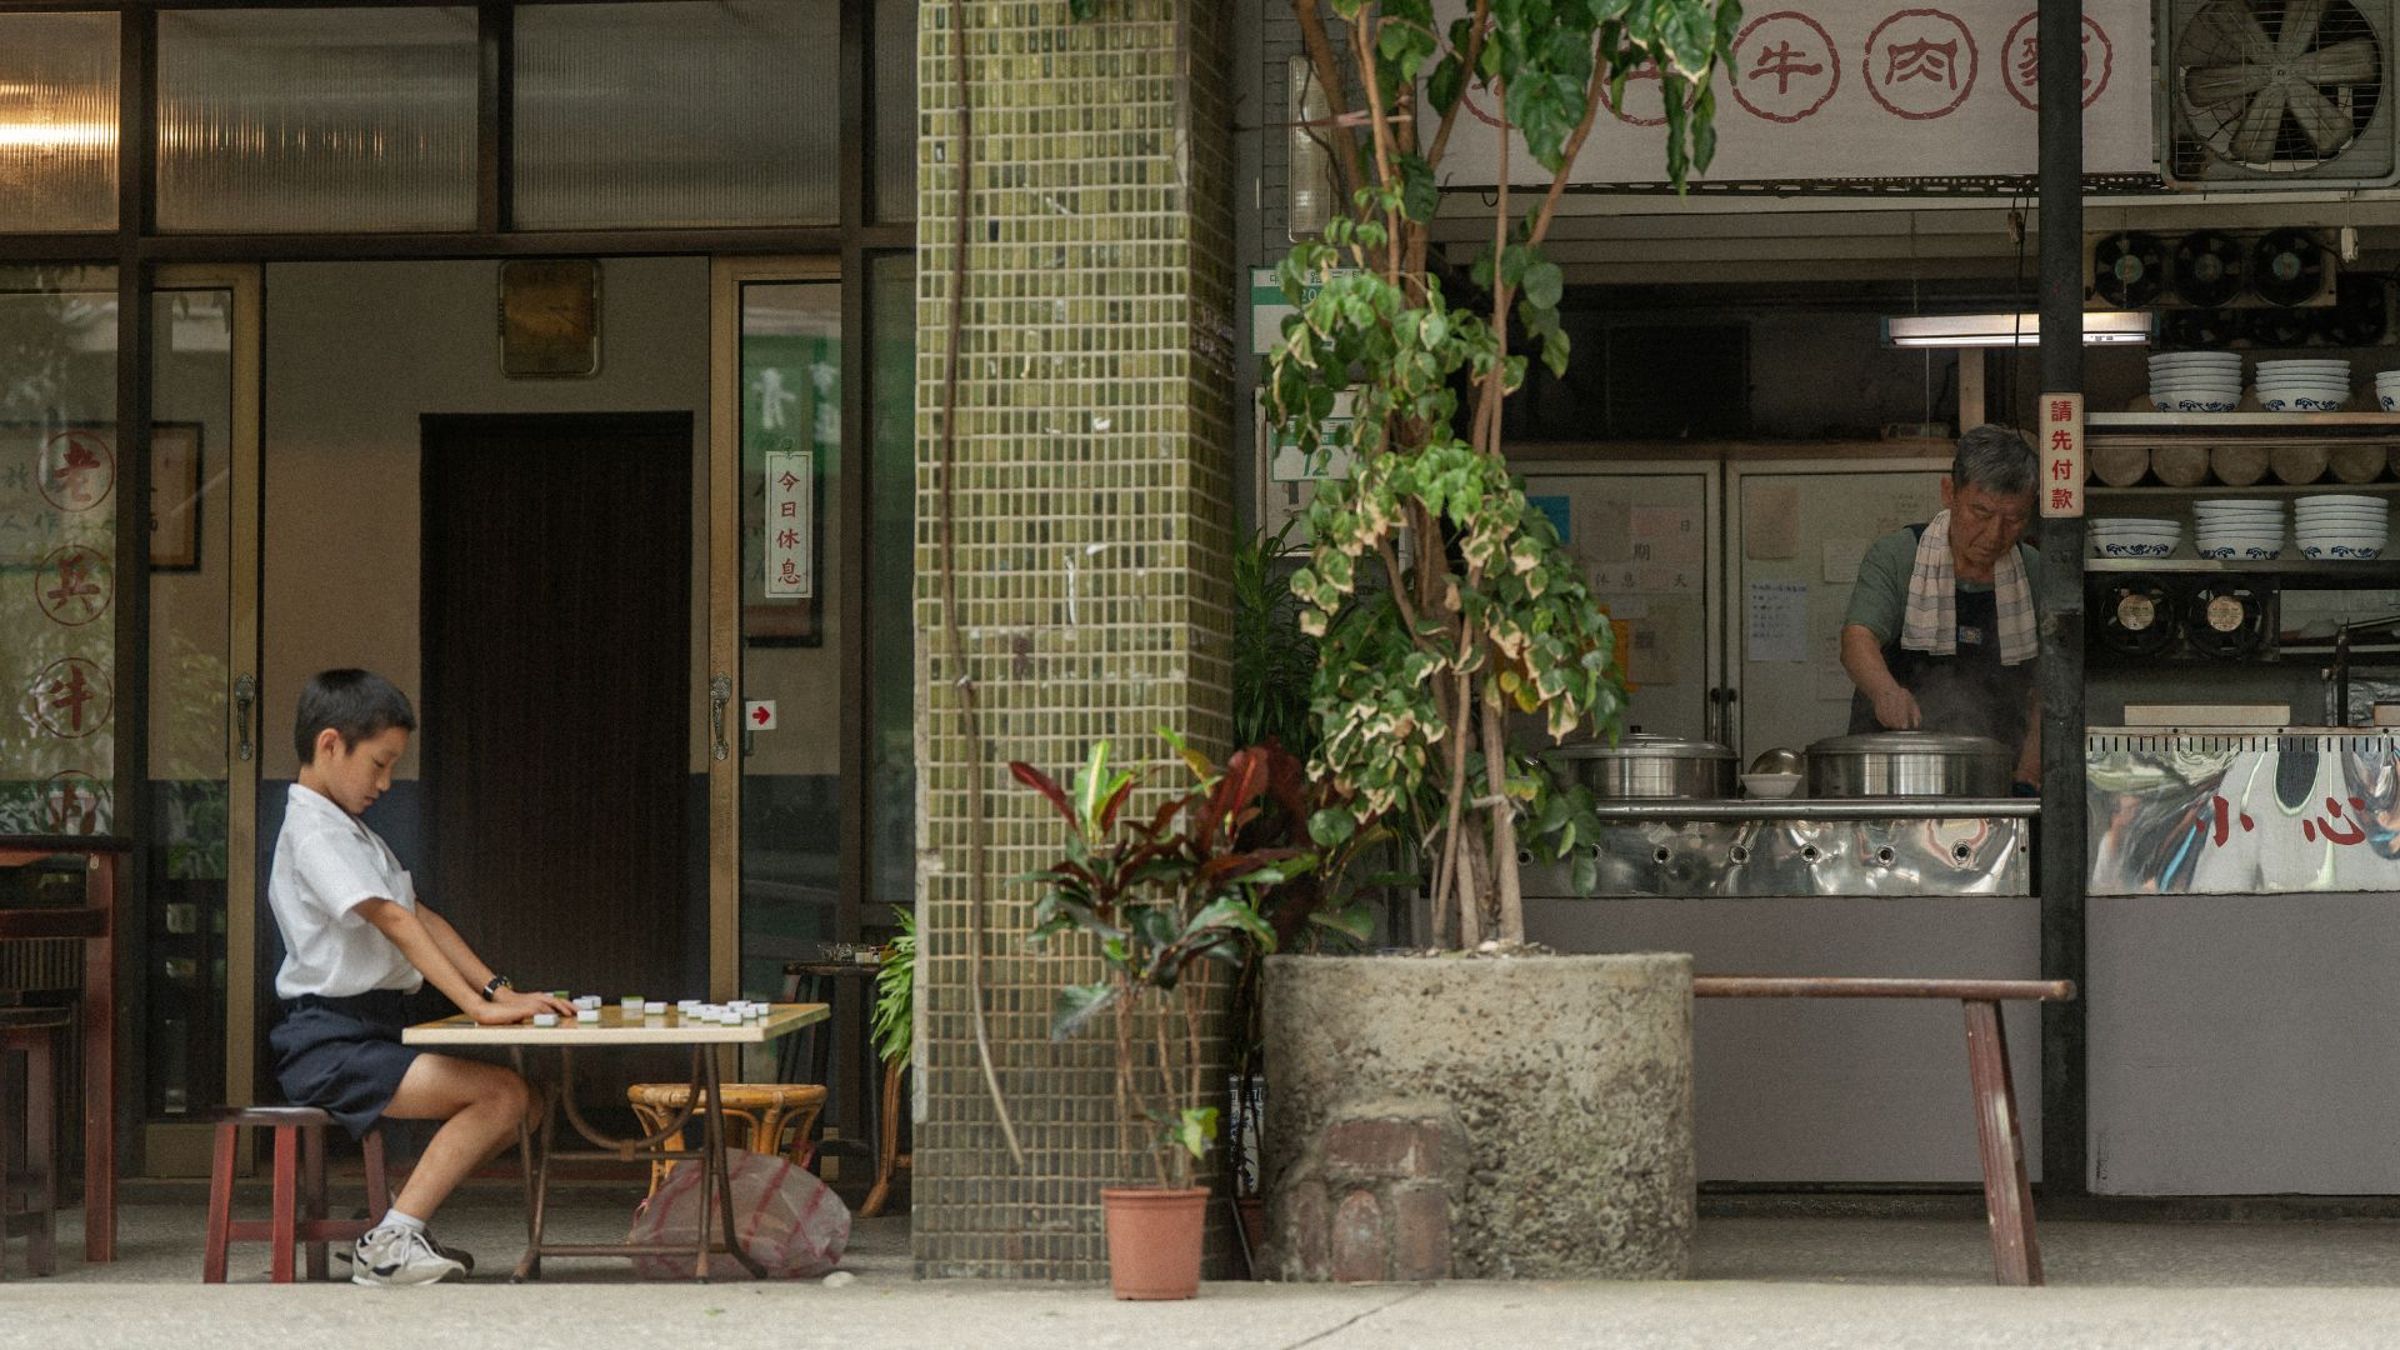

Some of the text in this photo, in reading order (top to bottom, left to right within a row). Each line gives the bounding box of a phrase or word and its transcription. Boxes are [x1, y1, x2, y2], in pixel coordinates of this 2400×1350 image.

[2051, 400, 2073, 510] 請先付款
[776, 470, 801, 585] 今日休息
[2196, 796, 2366, 848] 小心
